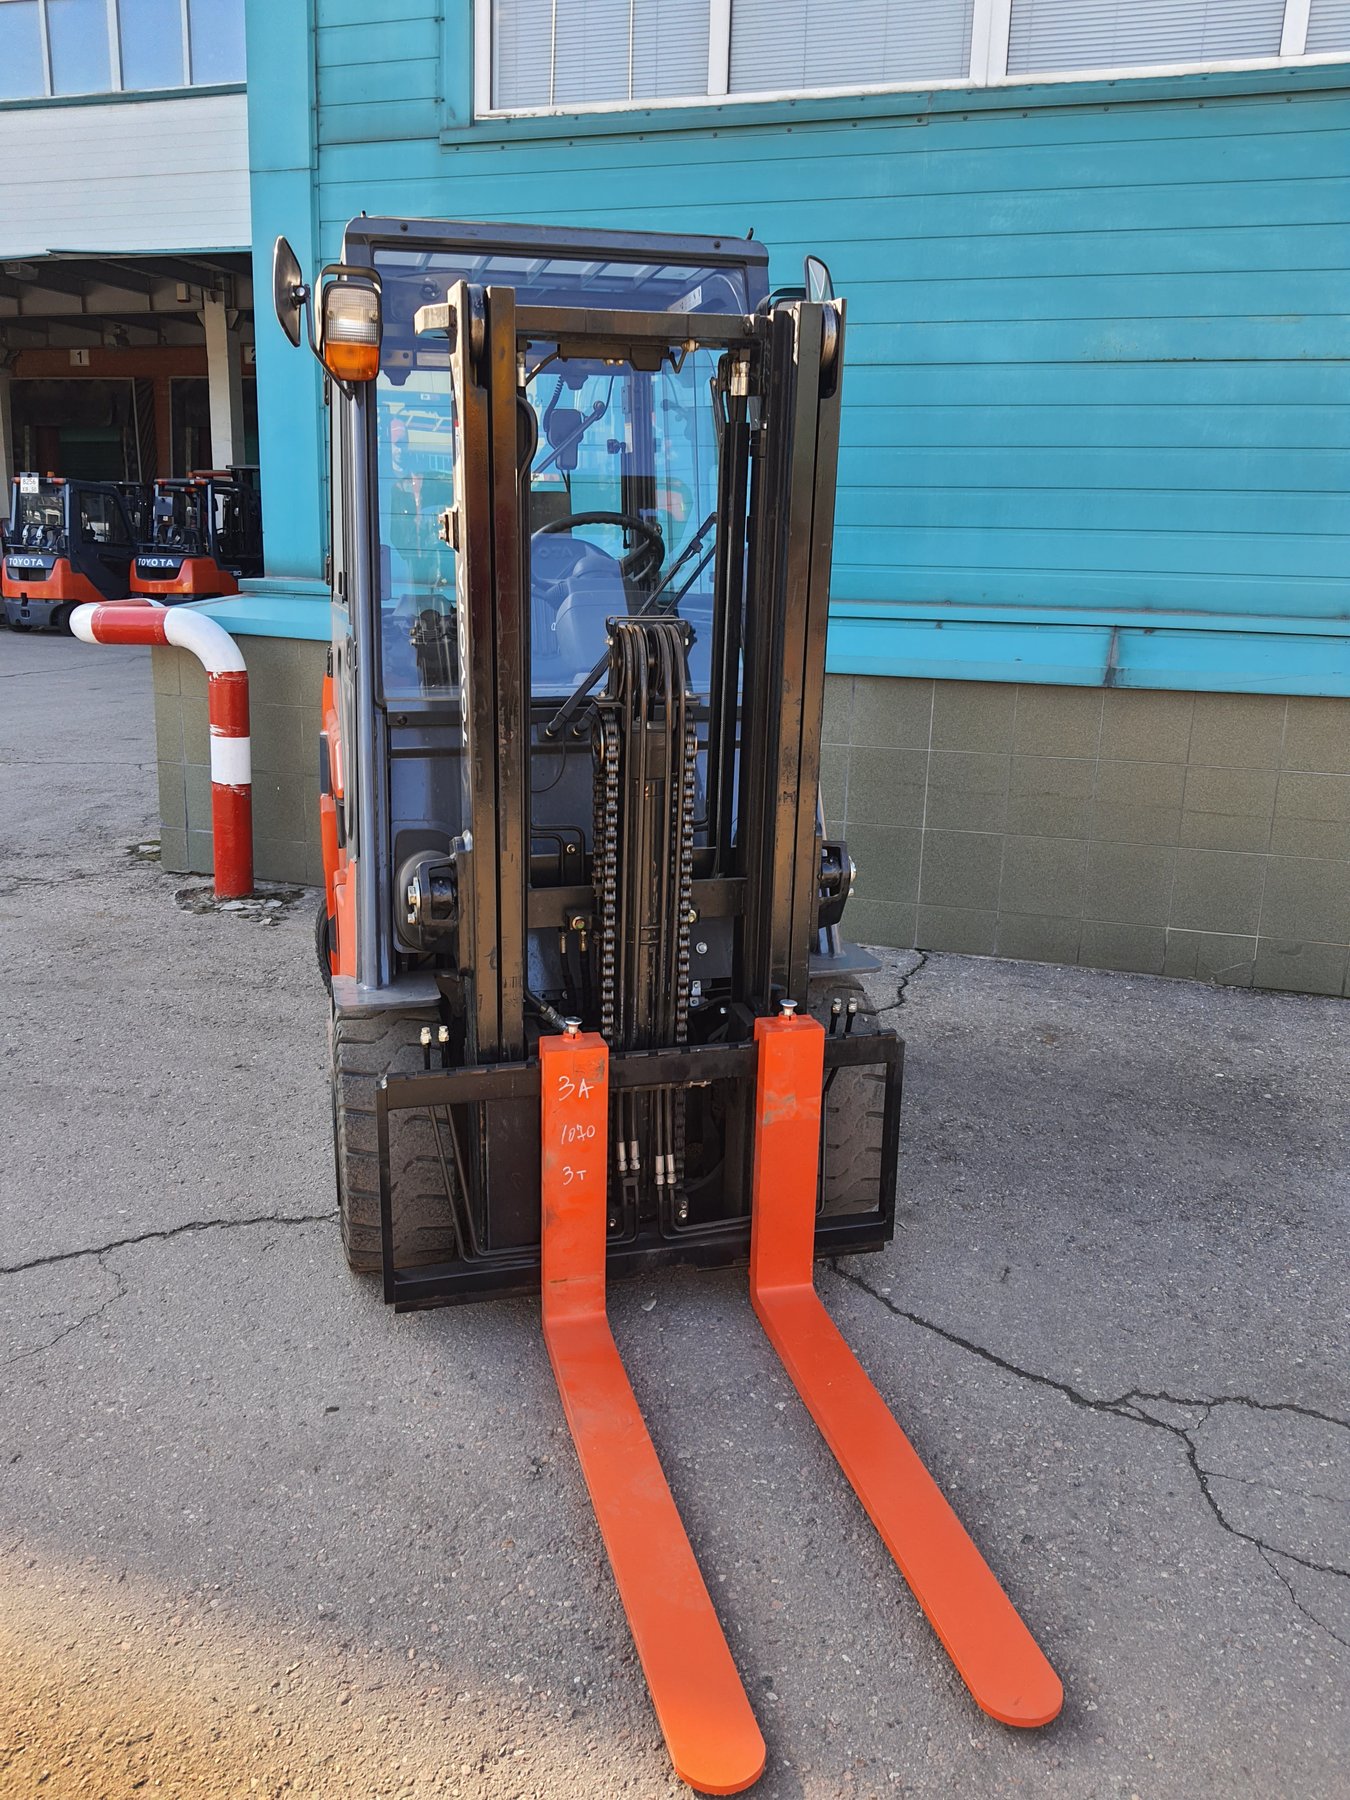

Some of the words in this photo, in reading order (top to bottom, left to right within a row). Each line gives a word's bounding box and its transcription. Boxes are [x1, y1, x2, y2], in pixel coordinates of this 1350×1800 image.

[77, 351, 82, 363] 1
[9, 558, 43, 566] TOYOTA
[138, 558, 174, 566] TOYOTA
[561, 1124, 596, 1145] 1070
